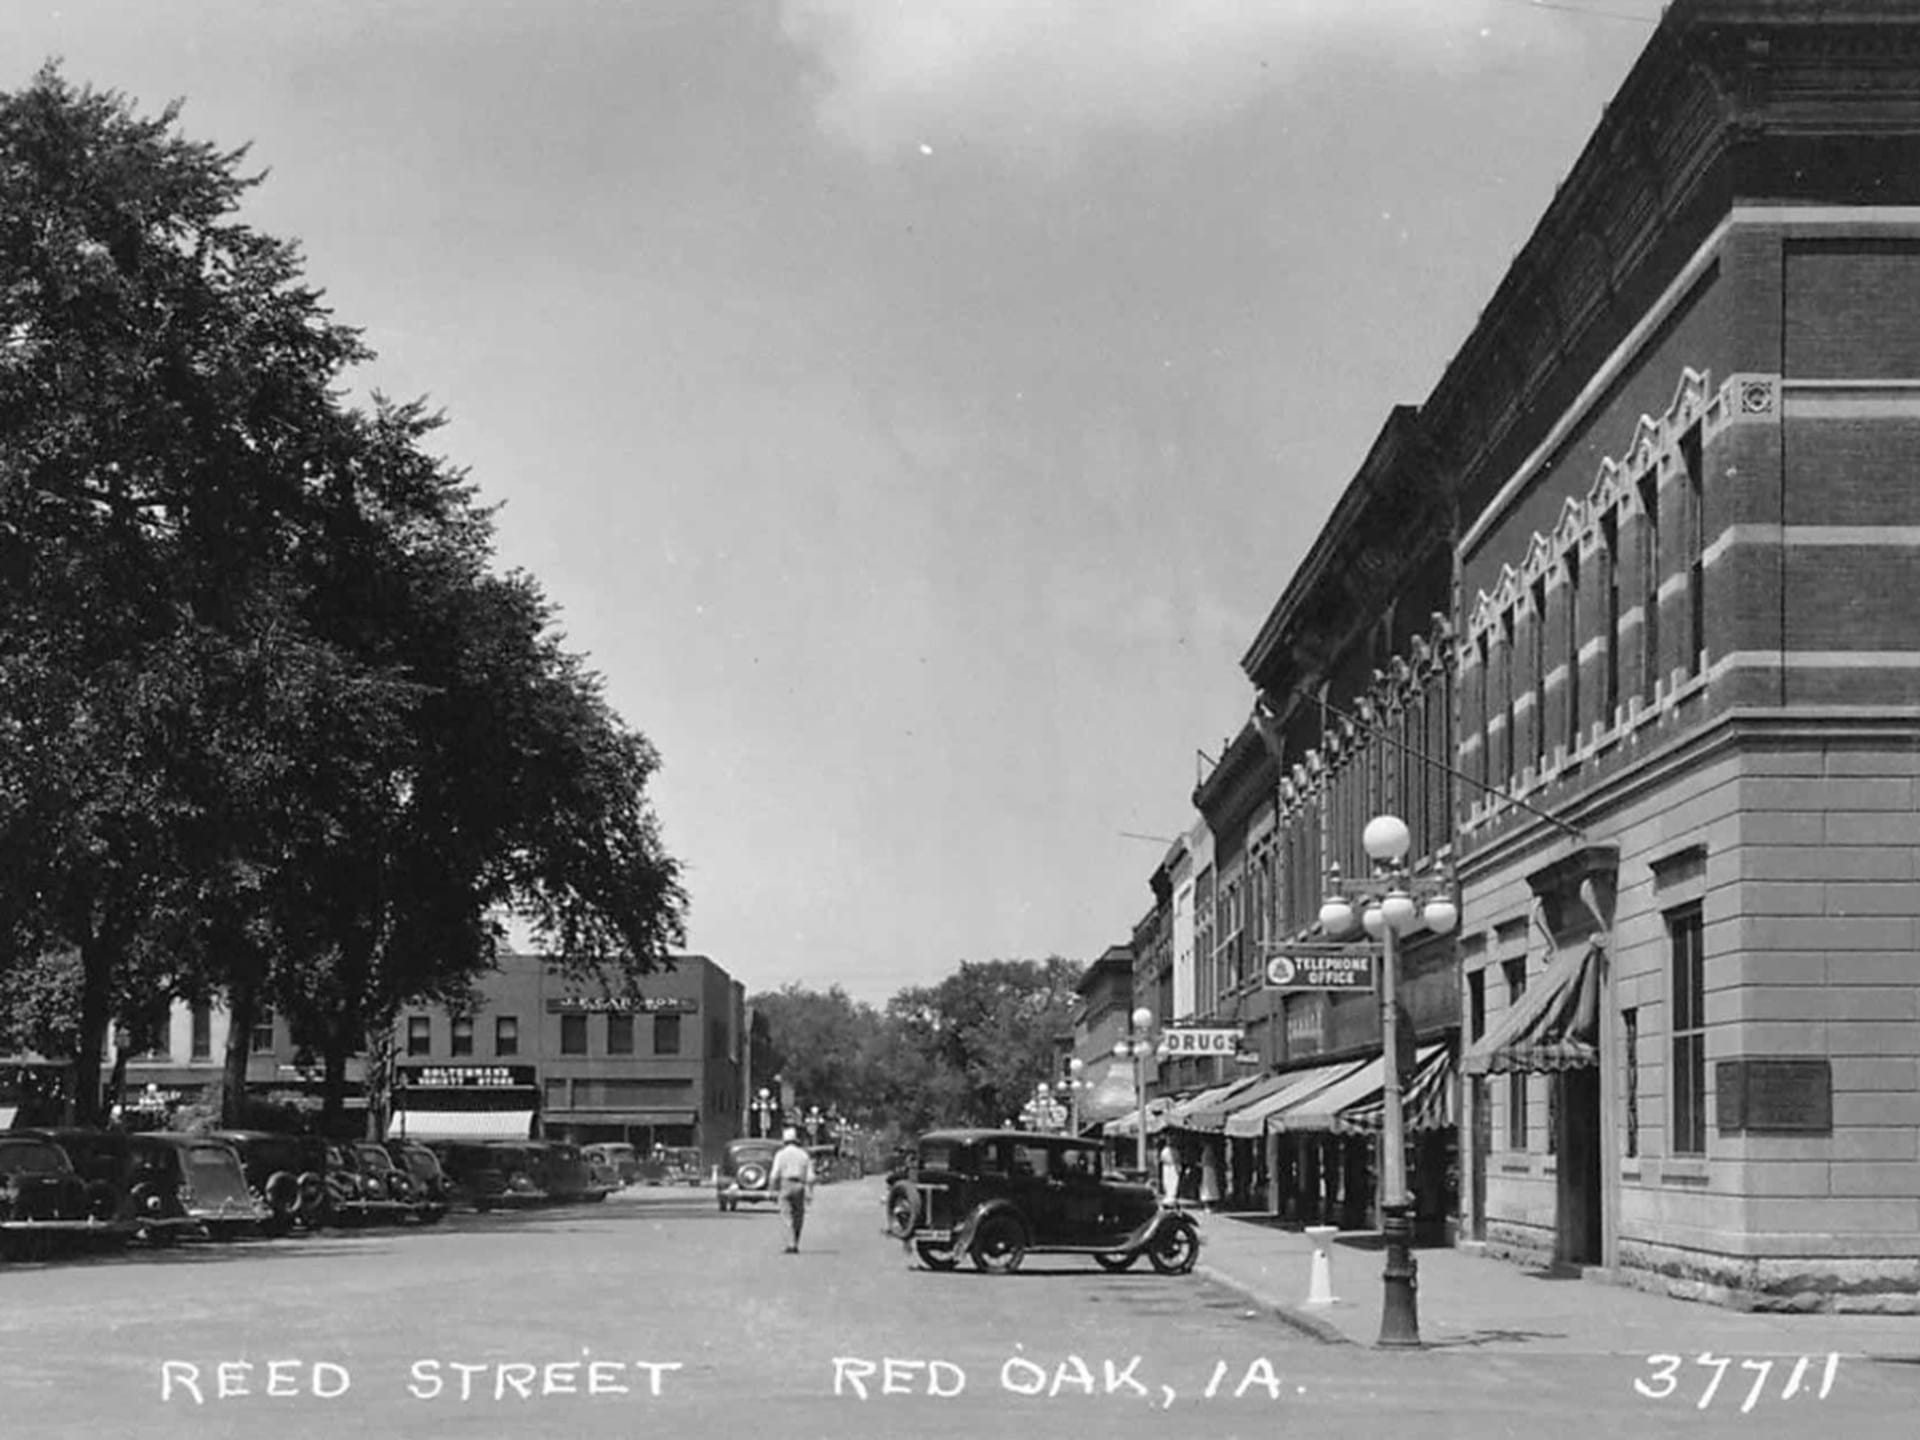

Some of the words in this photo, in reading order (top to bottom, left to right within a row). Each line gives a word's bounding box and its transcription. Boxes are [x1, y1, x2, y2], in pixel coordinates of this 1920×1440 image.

[1294, 957, 1369, 971] TELEPHONE
[1308, 971, 1355, 984] OFFICE
[1168, 1034, 1237, 1051] DRUGS
